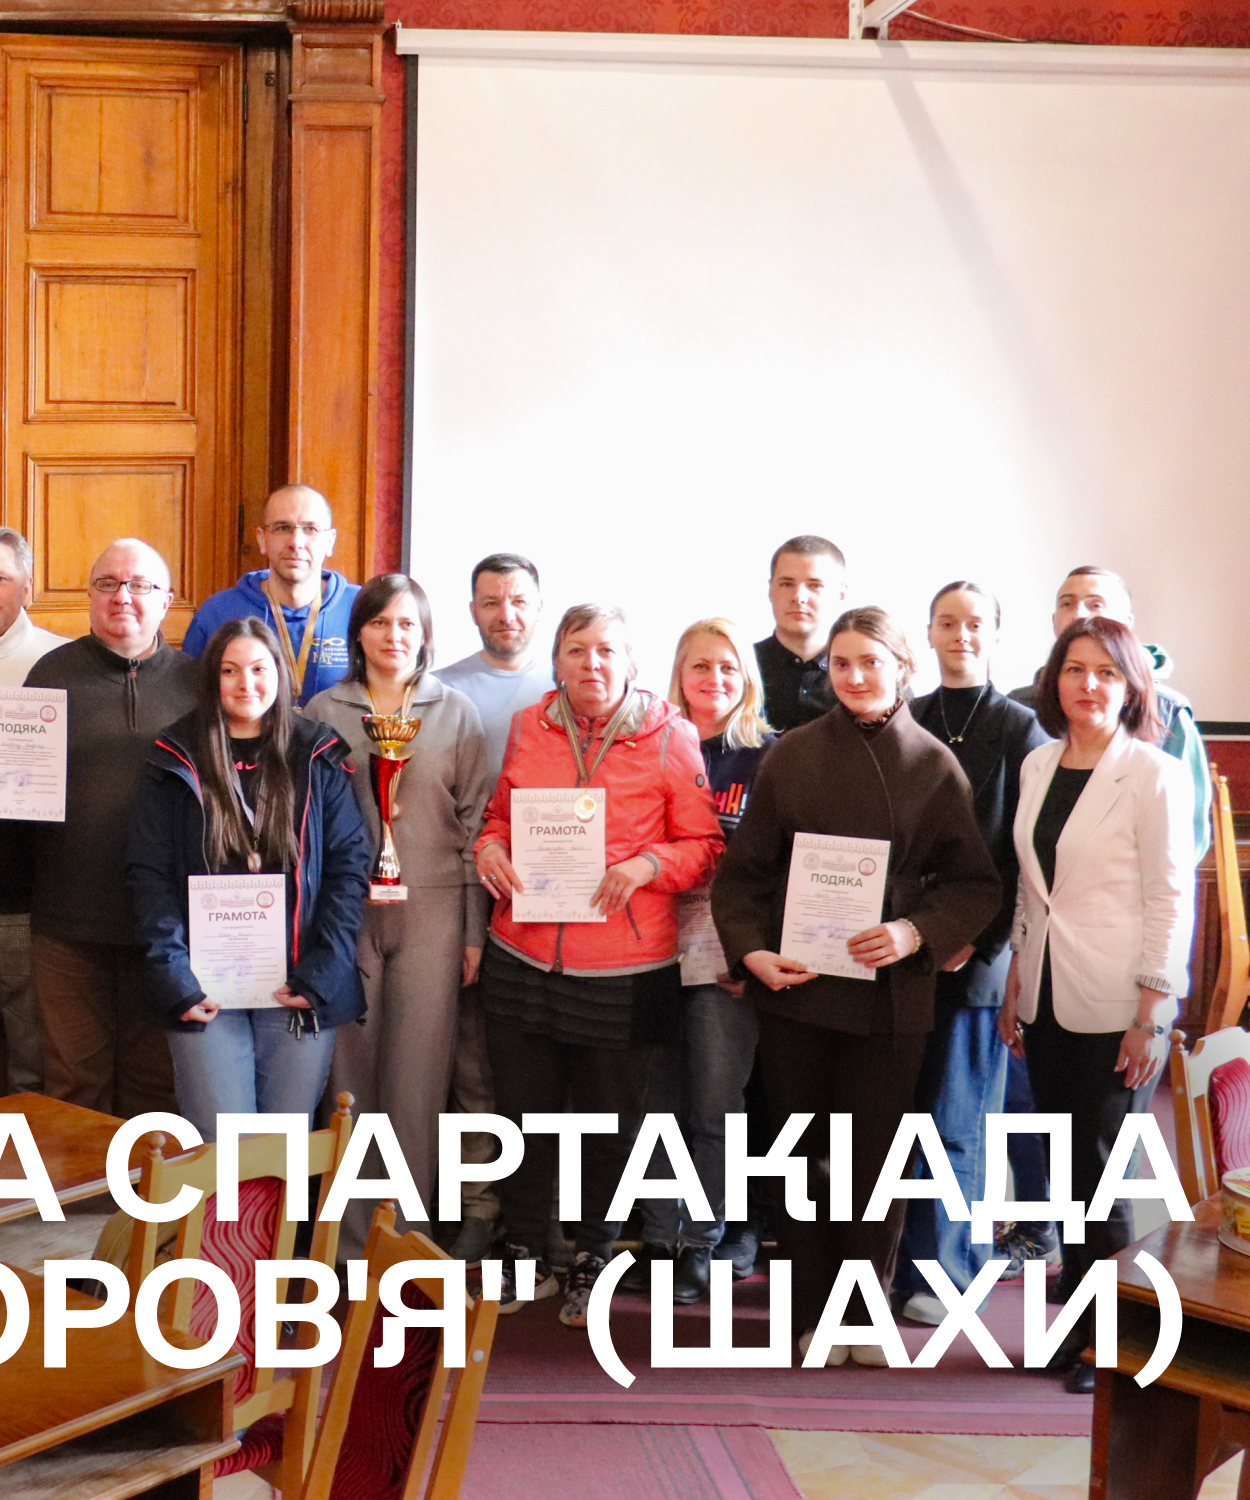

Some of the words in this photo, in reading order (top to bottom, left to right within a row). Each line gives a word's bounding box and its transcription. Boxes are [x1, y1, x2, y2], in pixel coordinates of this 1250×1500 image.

[529, 826, 587, 836] ГРАМОТА
[810, 873, 863, 888] ПОДЯКА
[208, 911, 267, 922] ГРАМОТА
